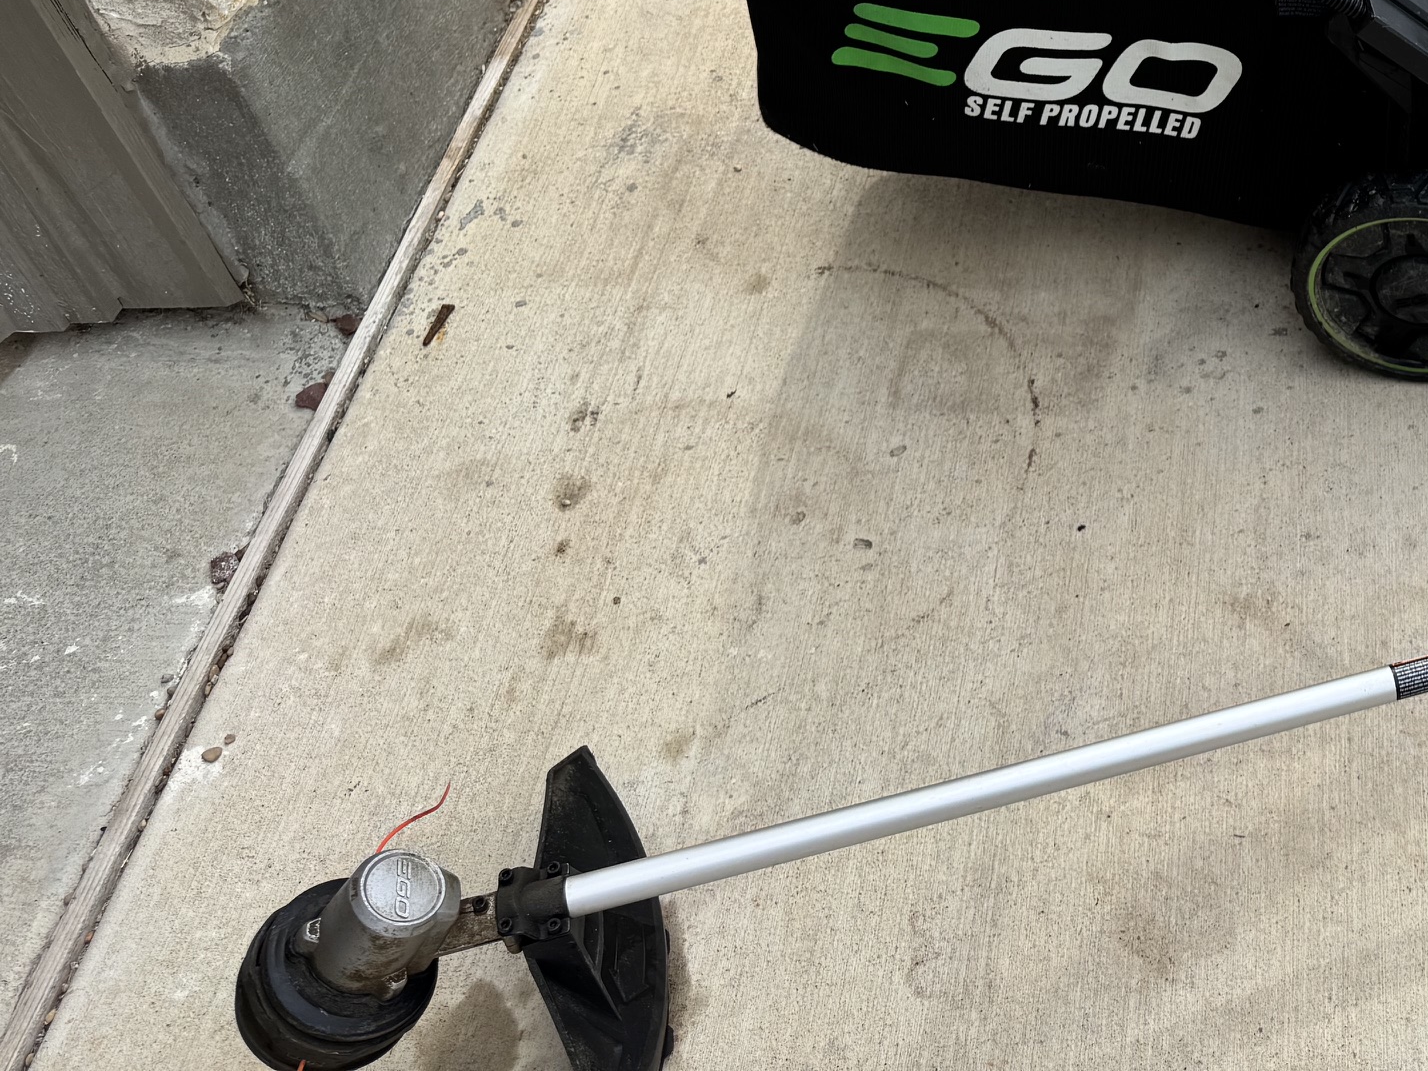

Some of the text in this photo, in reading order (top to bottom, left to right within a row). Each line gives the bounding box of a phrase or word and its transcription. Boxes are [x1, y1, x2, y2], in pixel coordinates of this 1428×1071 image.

[831, 2, 1242, 113] EGO
[964, 95, 1202, 139] SELF PROPELLED
[396, 859, 412, 918] EGO
